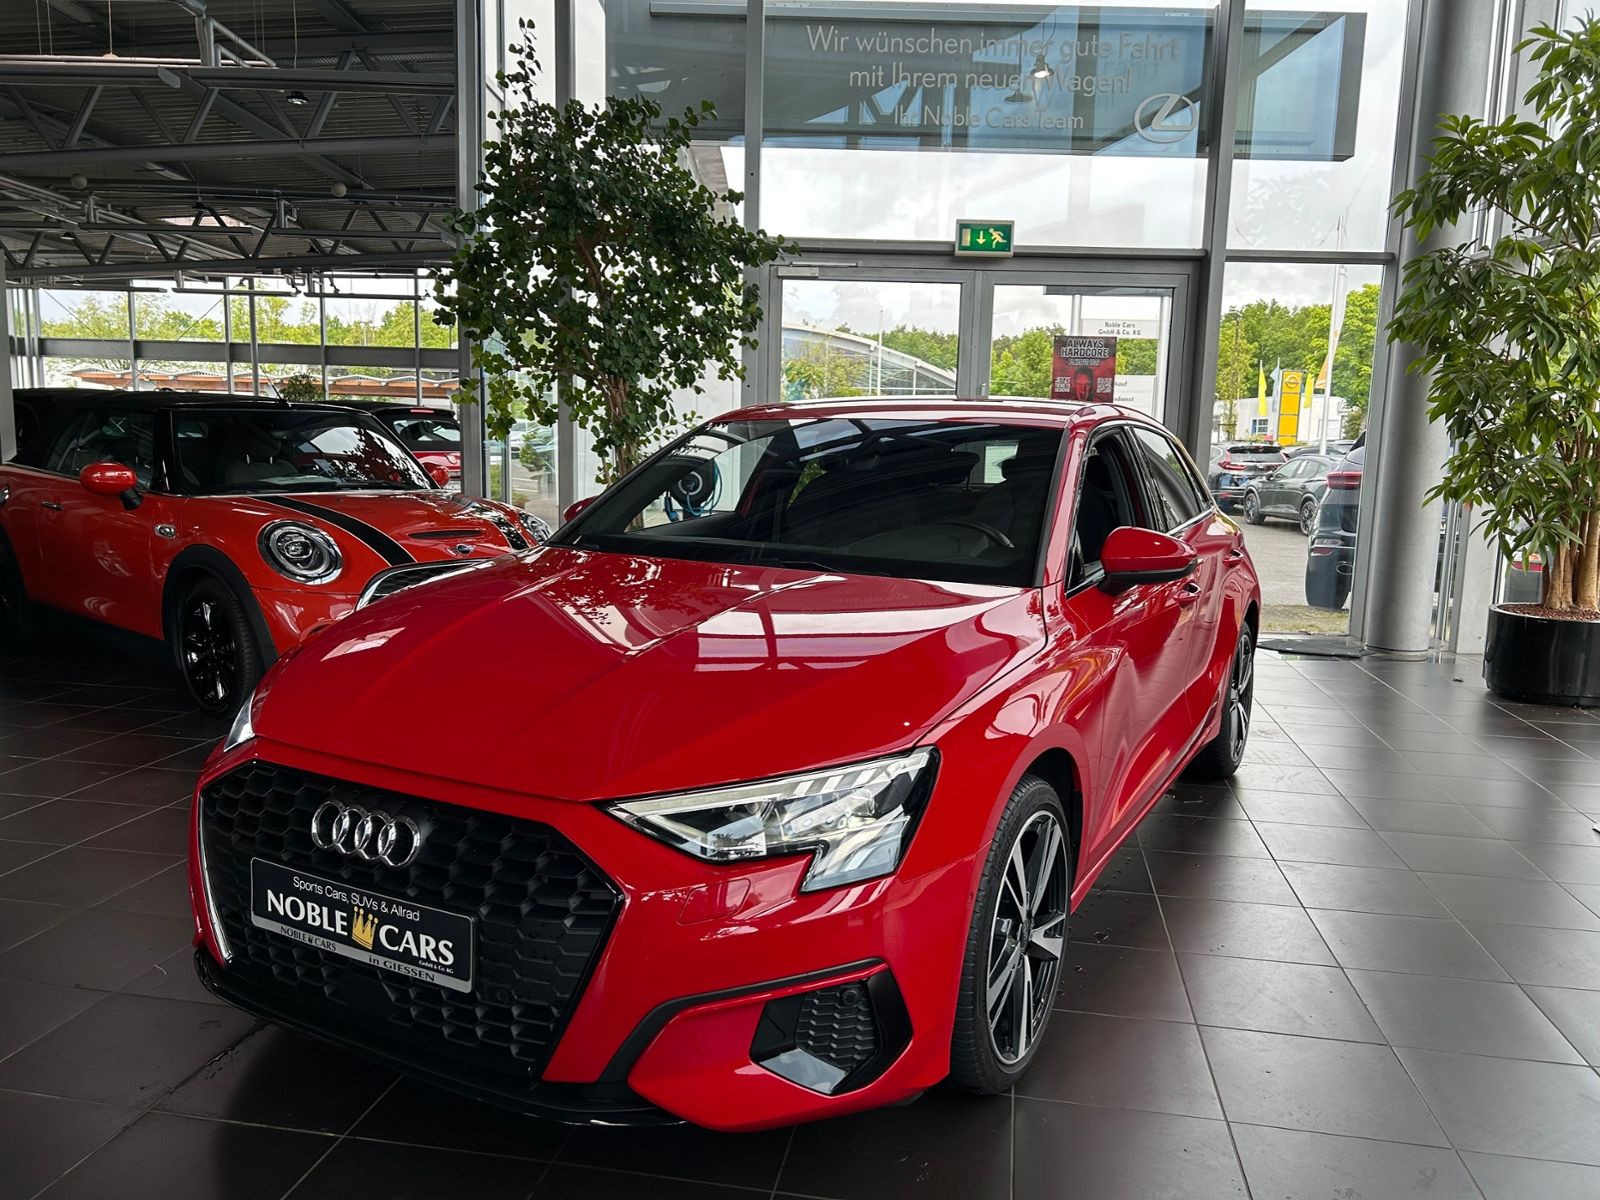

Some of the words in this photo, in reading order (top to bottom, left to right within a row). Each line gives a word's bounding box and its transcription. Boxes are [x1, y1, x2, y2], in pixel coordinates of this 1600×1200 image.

[806, 25, 849, 52] Wir
[856, 28, 972, 54] wünschen
[980, 32, 1054, 56] immer
[1060, 34, 1109, 62] gute
[1119, 31, 1180, 60] Fahrt
[849, 65, 885, 87] mit
[892, 61, 958, 89] Ihrem
[1044, 64, 1132, 96] Wagen!
[894, 105, 917, 127] Ihr
[923, 105, 981, 128] Noble
[985, 107, 1031, 130] Cars
[1034, 107, 1084, 130] Team
[1061, 347, 1110, 358] HARDCORE
[1066, 338, 1105, 348] ALWAYS
[292, 876, 324, 895] Sports
[324, 885, 350, 904] Cars,
[351, 892, 379, 911] SUVs
[380, 901, 389, 914] &
[390, 903, 420, 922] Allrad
[267, 889, 348, 936] NOBLE
[379, 924, 455, 966] CARS
[280, 926, 307, 941] NOBLE
[314, 938, 337, 952] CARS
[369, 954, 380, 965] in
[383, 960, 435, 982] GIESSEN
